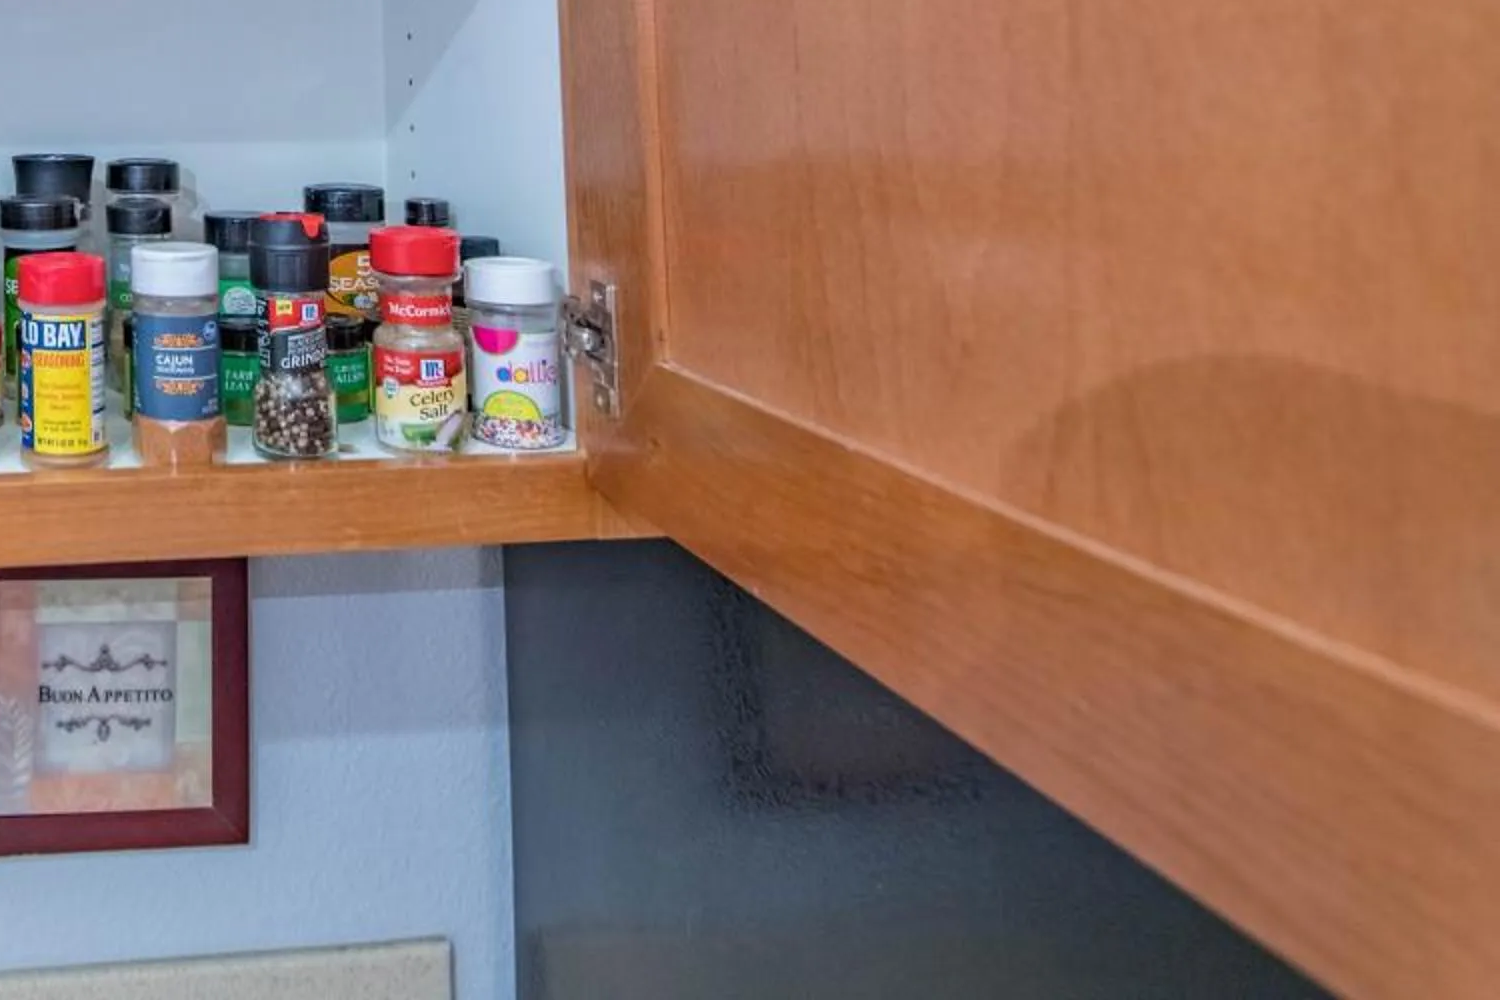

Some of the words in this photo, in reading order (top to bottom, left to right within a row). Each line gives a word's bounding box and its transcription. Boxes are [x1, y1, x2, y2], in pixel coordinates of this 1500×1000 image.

[21, 321, 38, 346] LD
[43, 324, 82, 349] BAY
[155, 354, 193, 366] CAJUN
[409, 389, 455, 407] Celery
[419, 404, 449, 421] Salt
[39, 686, 83, 704] BUON
[87, 686, 174, 703] APPETITO
